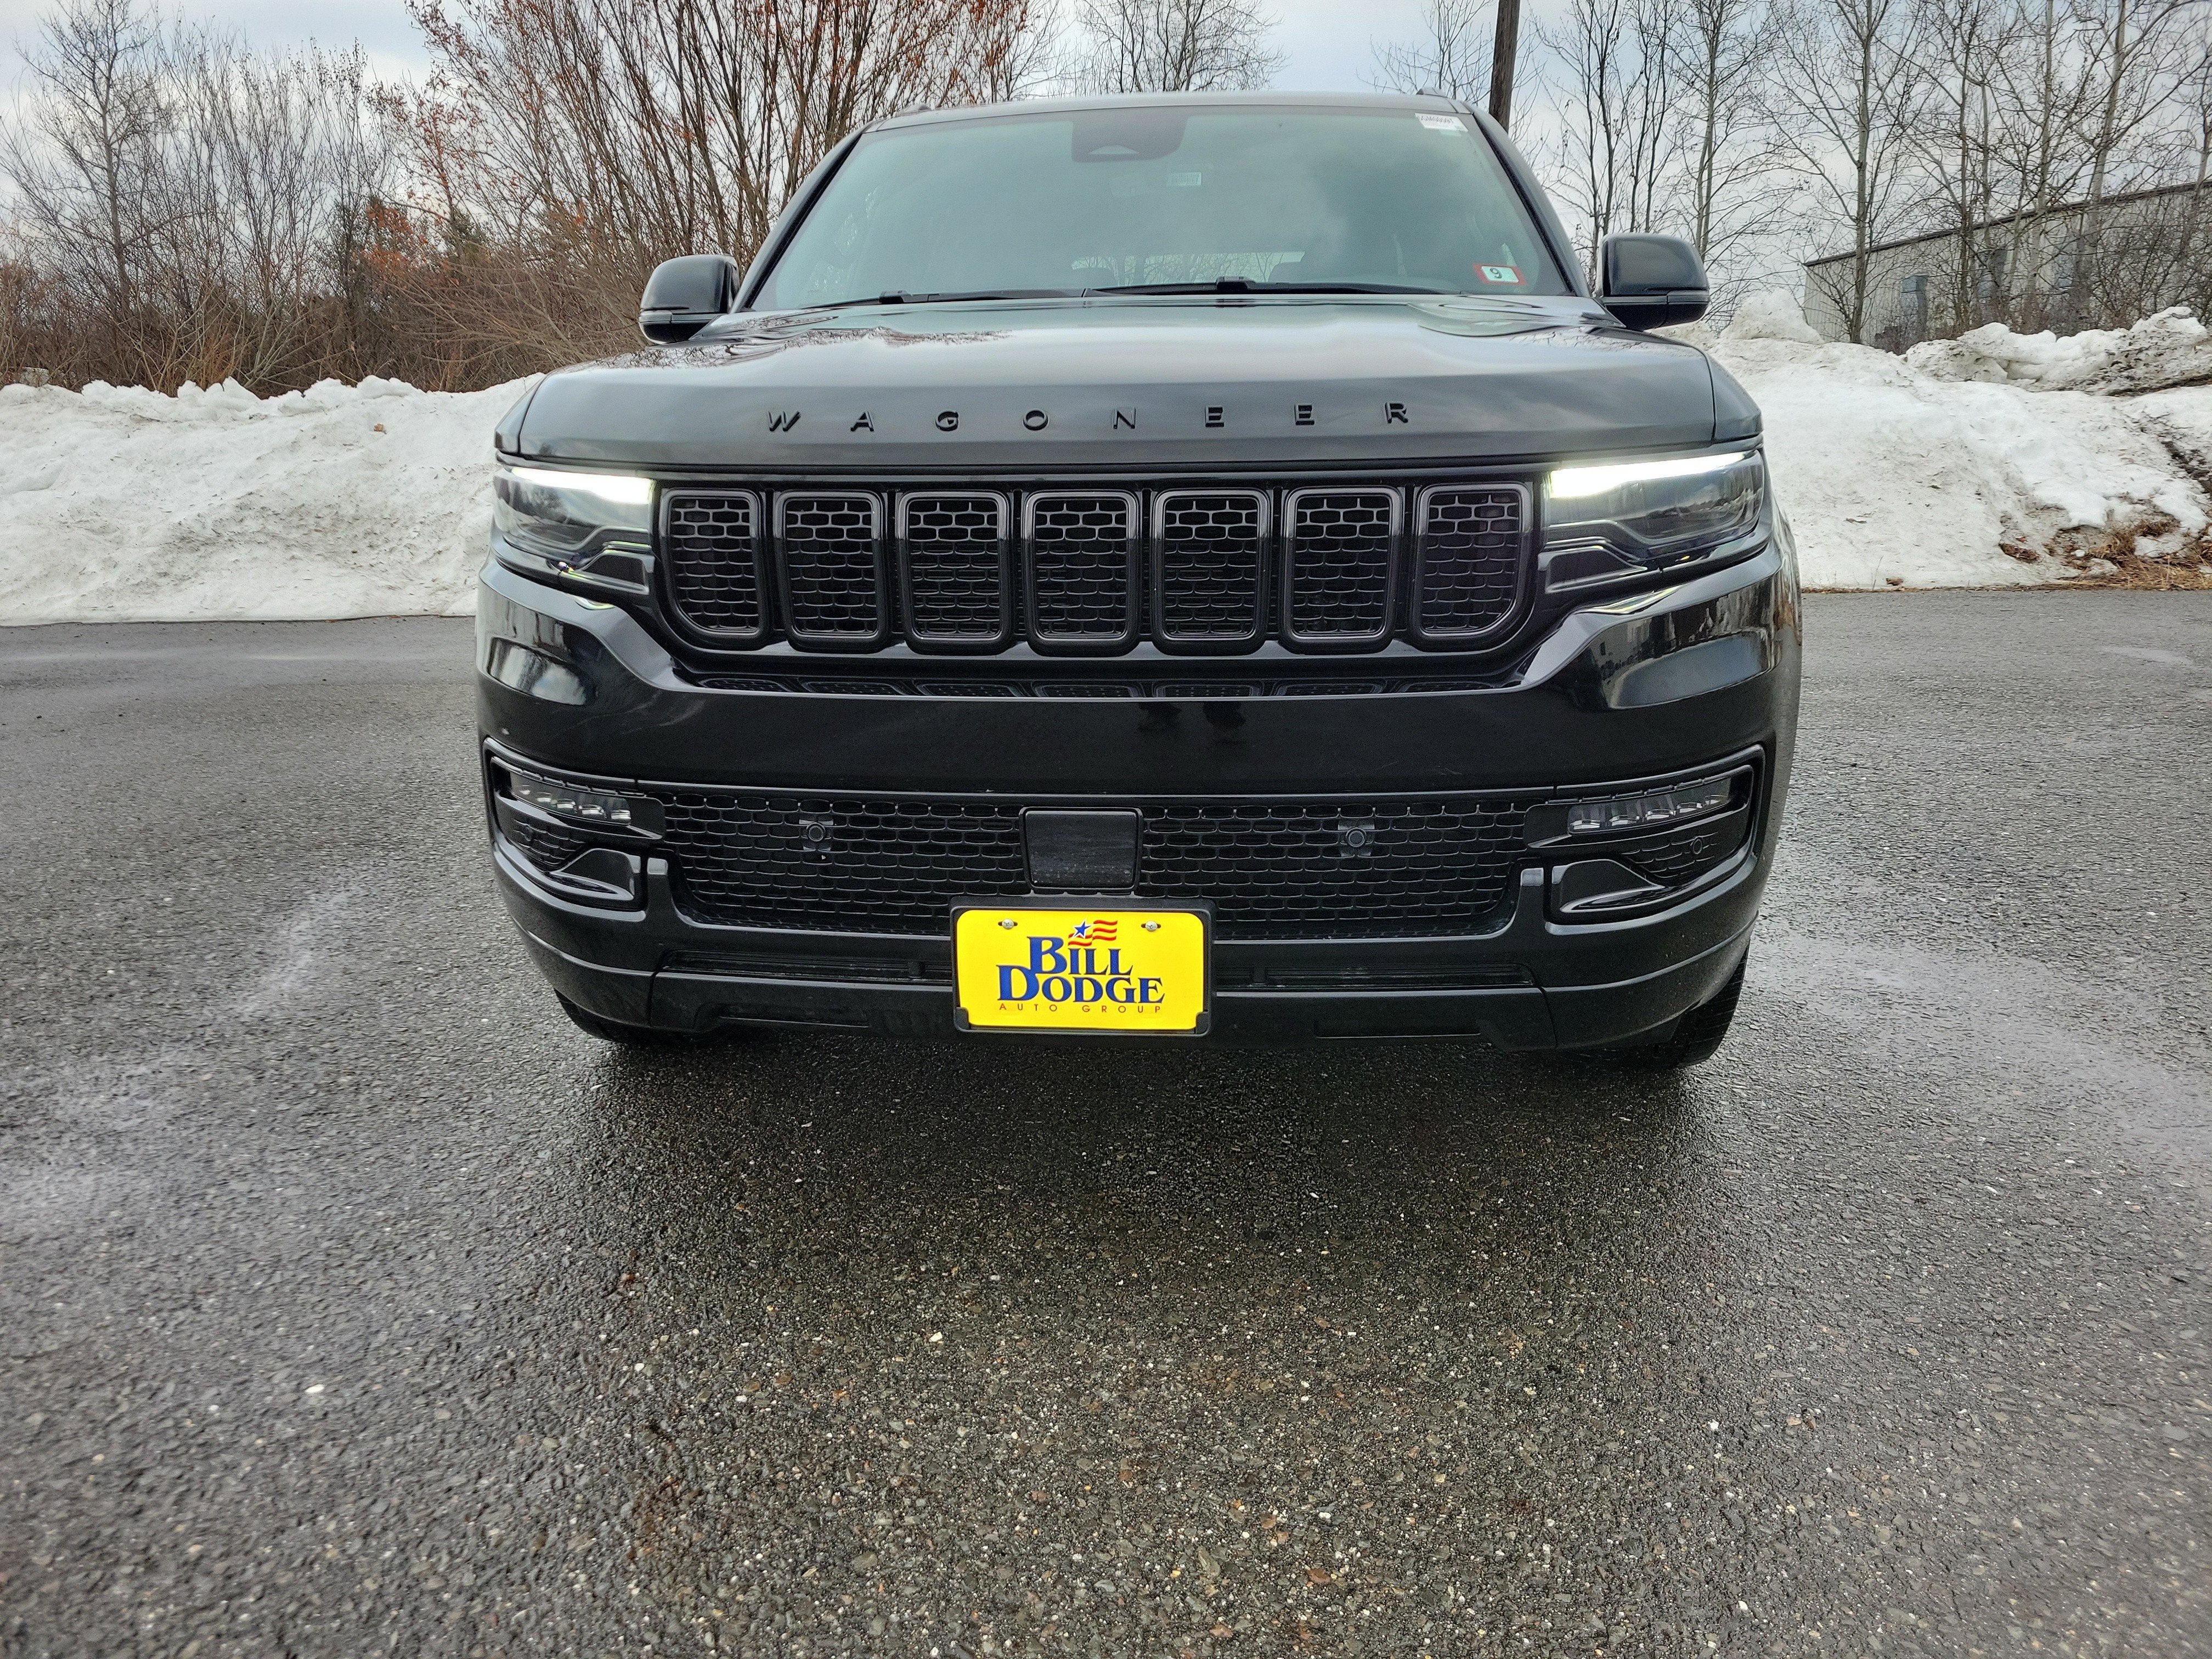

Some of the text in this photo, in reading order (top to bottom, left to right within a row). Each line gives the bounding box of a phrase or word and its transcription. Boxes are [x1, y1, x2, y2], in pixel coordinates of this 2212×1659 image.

[1489, 267, 1503, 279] 9
[768, 402, 1409, 432] WAGONEER
[1026, 935, 1133, 975] BILL
[996, 964, 1165, 1004] DODGE
[998, 1003, 1161, 1014] AUTO GROUP
